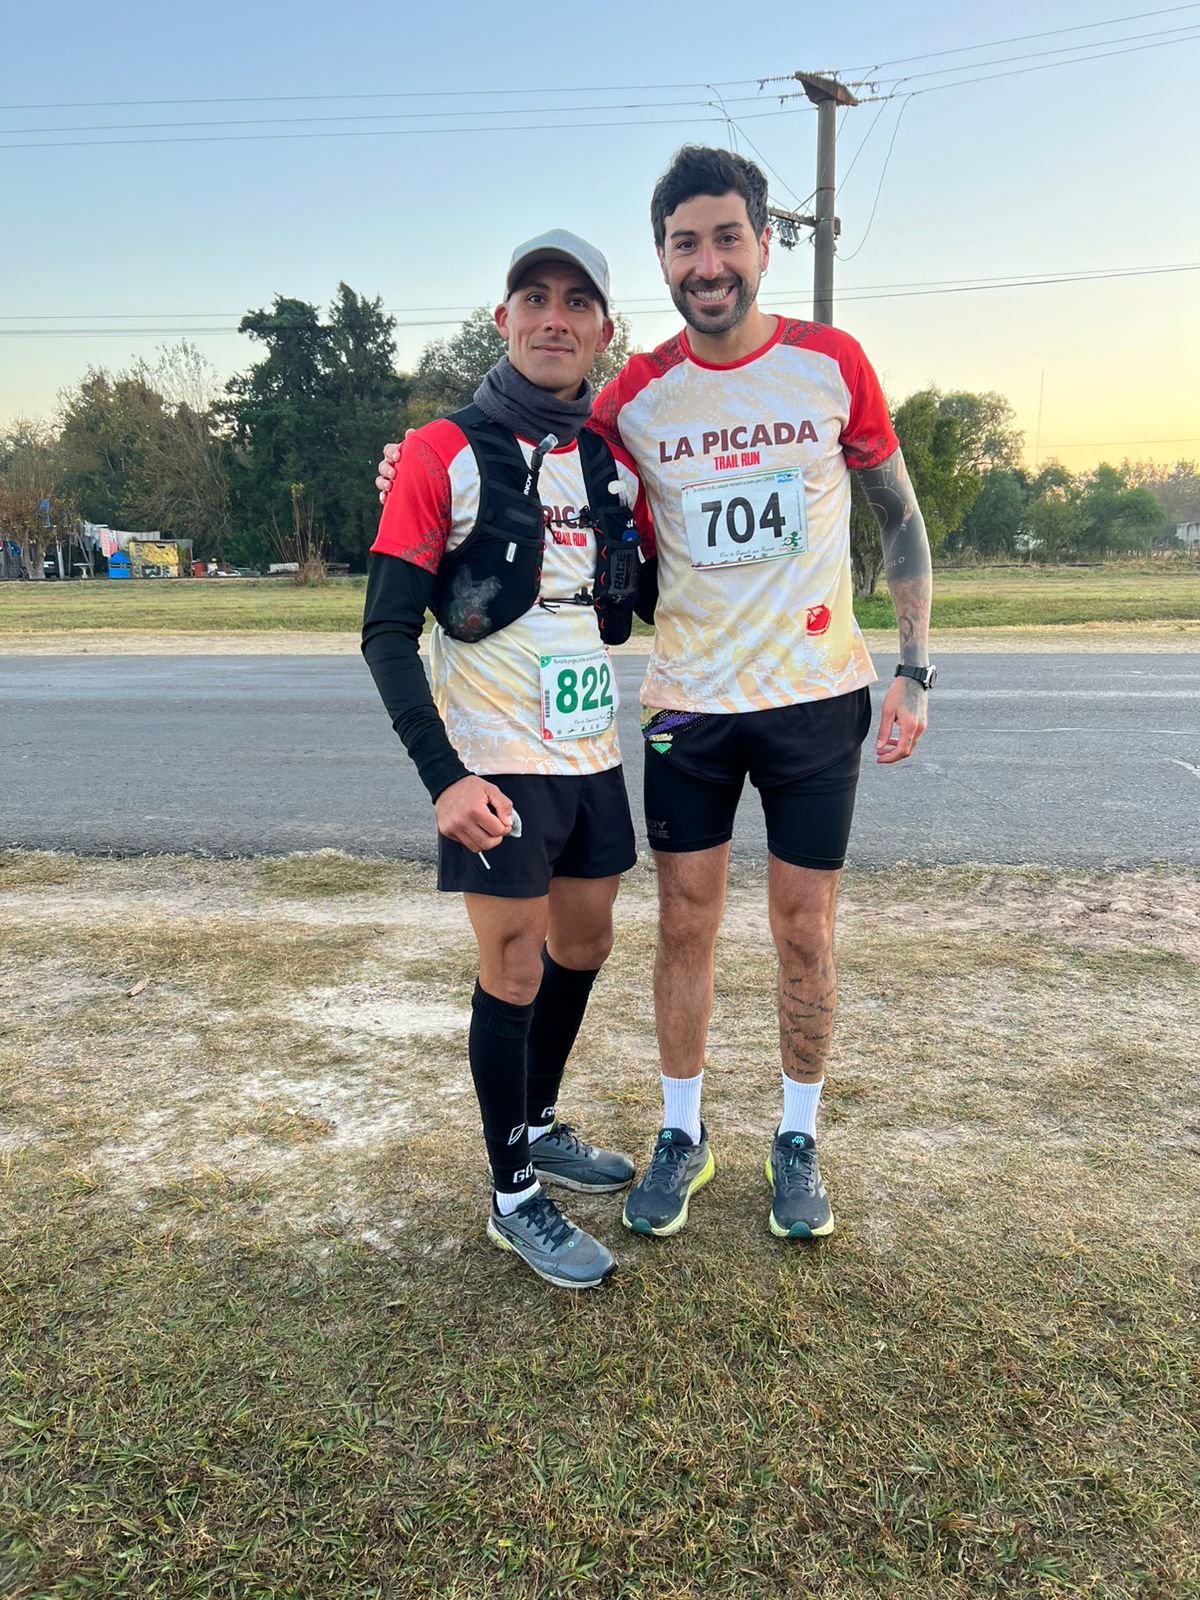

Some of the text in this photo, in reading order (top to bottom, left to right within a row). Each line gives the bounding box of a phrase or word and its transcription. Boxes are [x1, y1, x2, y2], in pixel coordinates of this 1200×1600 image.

[659, 420, 819, 463] LA PICADA
[714, 451, 760, 471] TRAIL RUN
[572, 532, 588, 547] RUN
[701, 492, 786, 547] 704
[556, 662, 614, 714] 822
